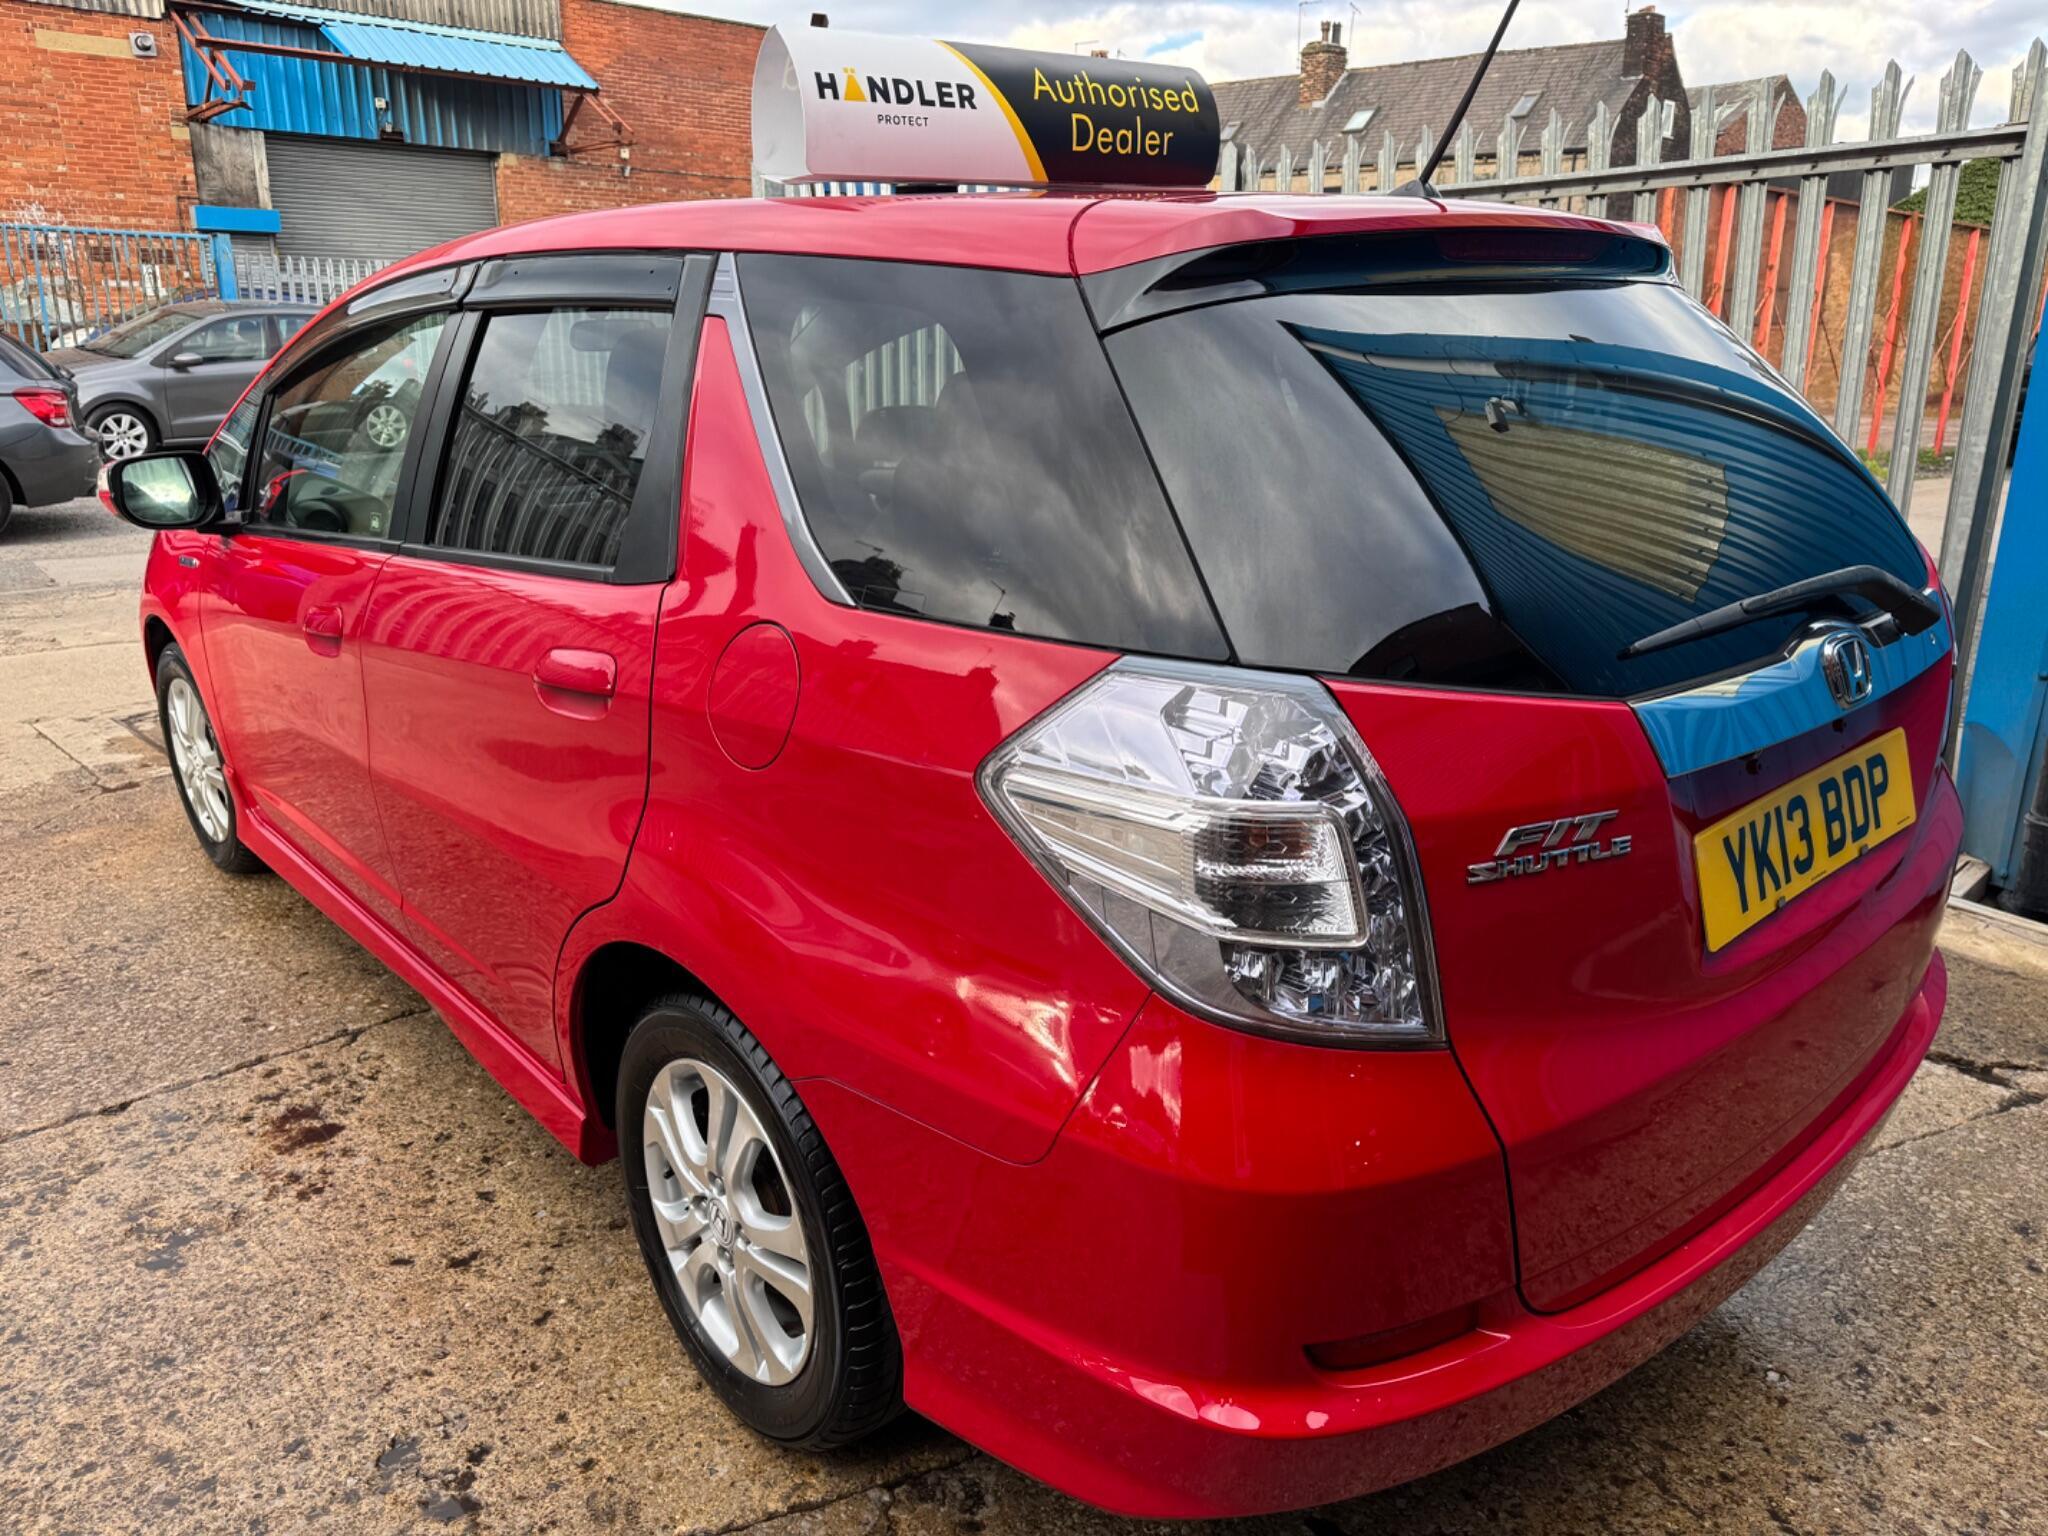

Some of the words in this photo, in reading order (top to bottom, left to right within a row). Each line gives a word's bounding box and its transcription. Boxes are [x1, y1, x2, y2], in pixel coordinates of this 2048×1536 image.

[814, 67, 977, 110] HÄNDLER
[1033, 67, 1200, 113] Authorised
[877, 114, 929, 127] PROTECT
[1071, 112, 1174, 156] Dealer
[1493, 809, 1620, 857] FIT
[1722, 794, 1815, 914] YK13
[1818, 753, 1888, 858] BDP
[1467, 835, 1632, 884] SHUTTLE
